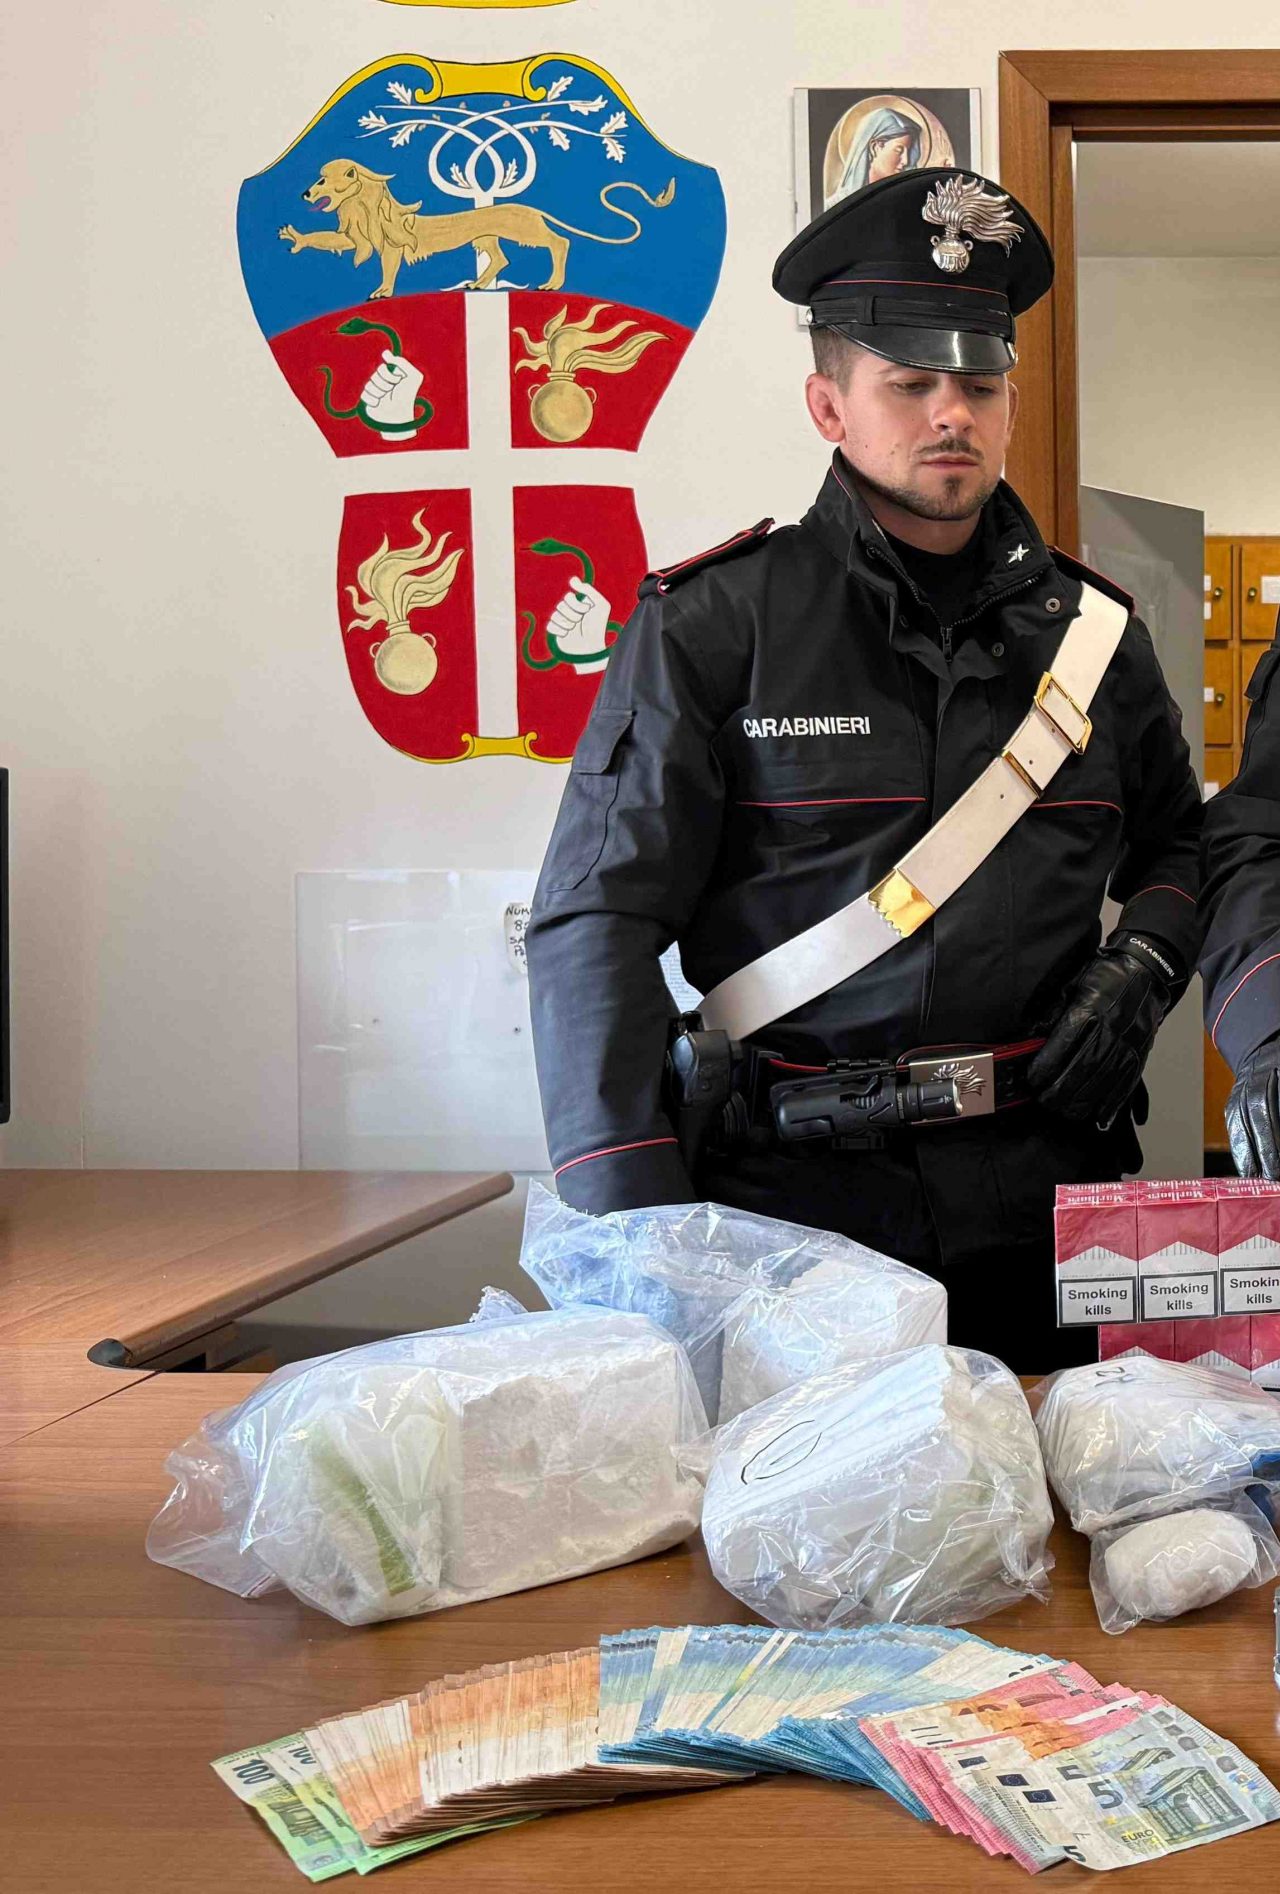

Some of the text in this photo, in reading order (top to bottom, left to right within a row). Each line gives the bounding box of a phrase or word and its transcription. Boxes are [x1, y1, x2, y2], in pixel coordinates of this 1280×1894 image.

[743, 716, 871, 738] CARABINIERI
[1129, 937, 1175, 977] CARABINIERI
[1068, 1287, 1128, 1301] Smoking
[1150, 1282, 1209, 1296] Smoking
[1166, 1300, 1193, 1311] kills
[1246, 1293, 1273, 1304] kills
[1085, 1304, 1112, 1316] kills
[232, 1759, 275, 1785] 100
[1087, 1779, 1124, 1809] 5
[1121, 1829, 1155, 1843] EURO
